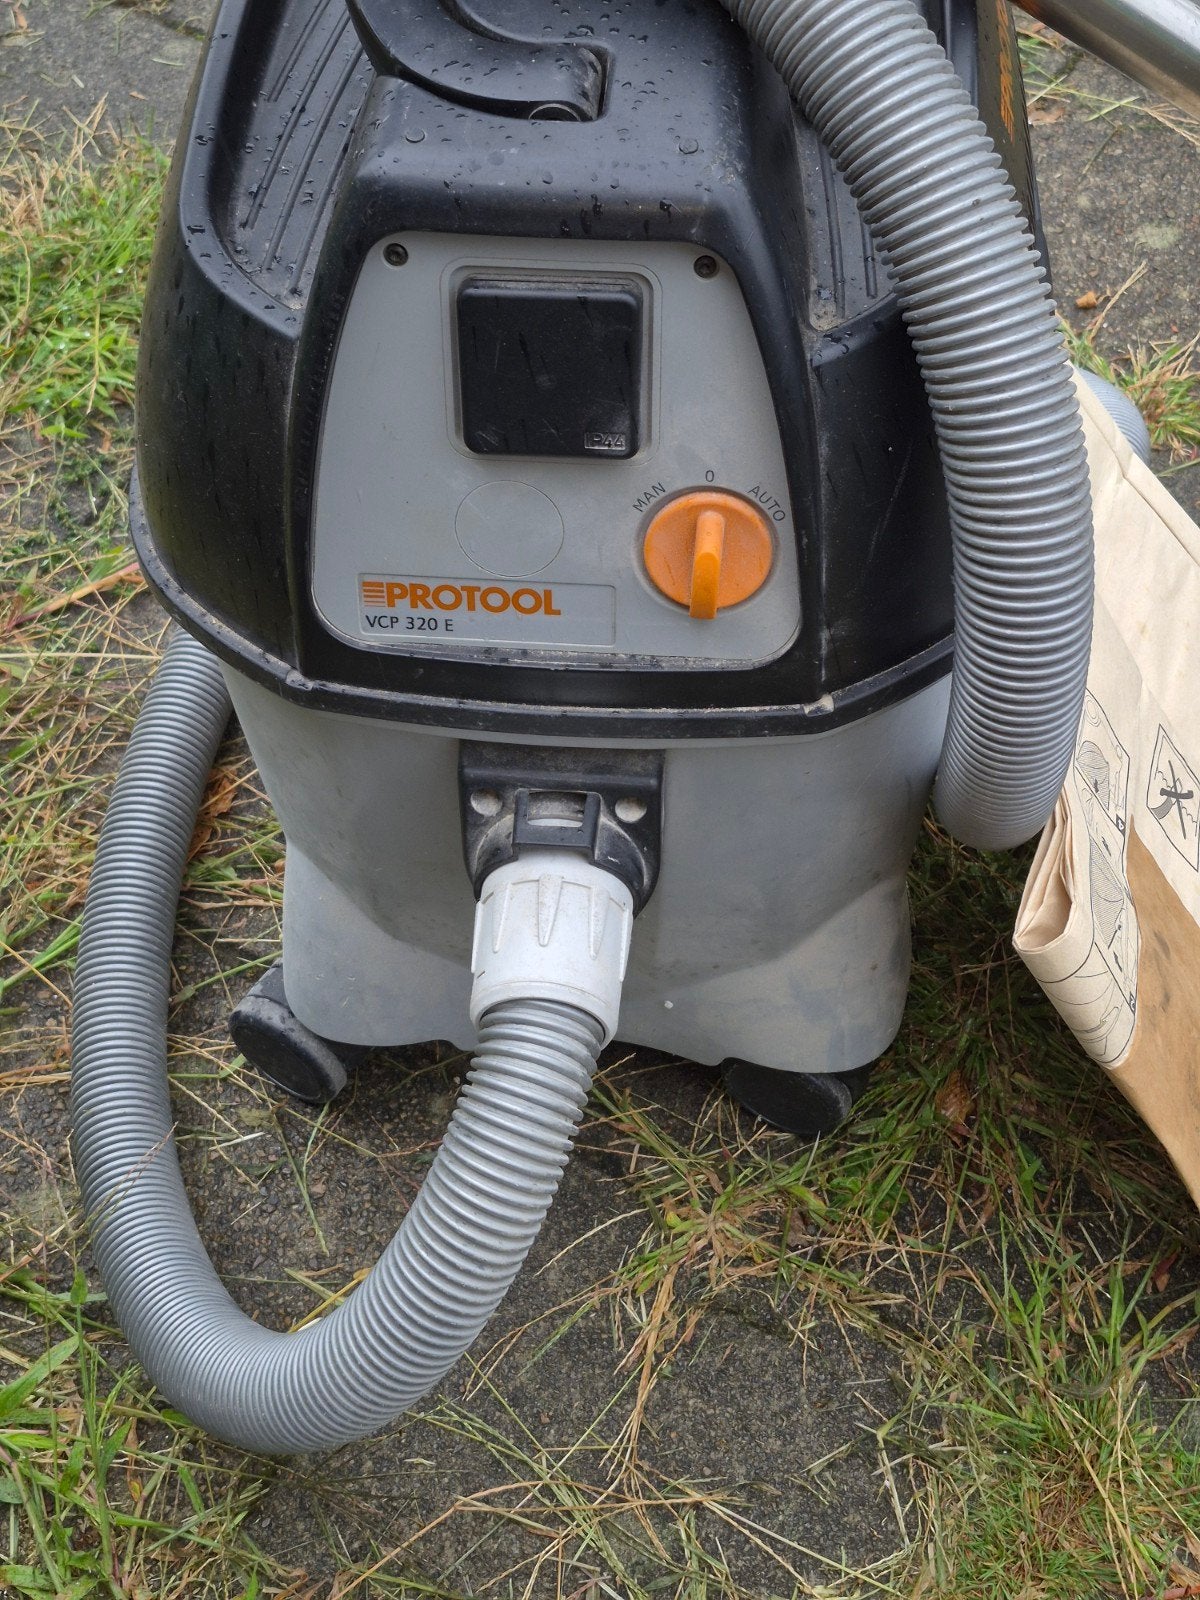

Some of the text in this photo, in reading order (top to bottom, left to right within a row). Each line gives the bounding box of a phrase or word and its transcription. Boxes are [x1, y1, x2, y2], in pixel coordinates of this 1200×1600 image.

[632, 482, 666, 513] MAN
[747, 485, 786, 522] AUTO
[385, 581, 561, 616] PROTOOL
[365, 615, 454, 632] VCP 320 E
